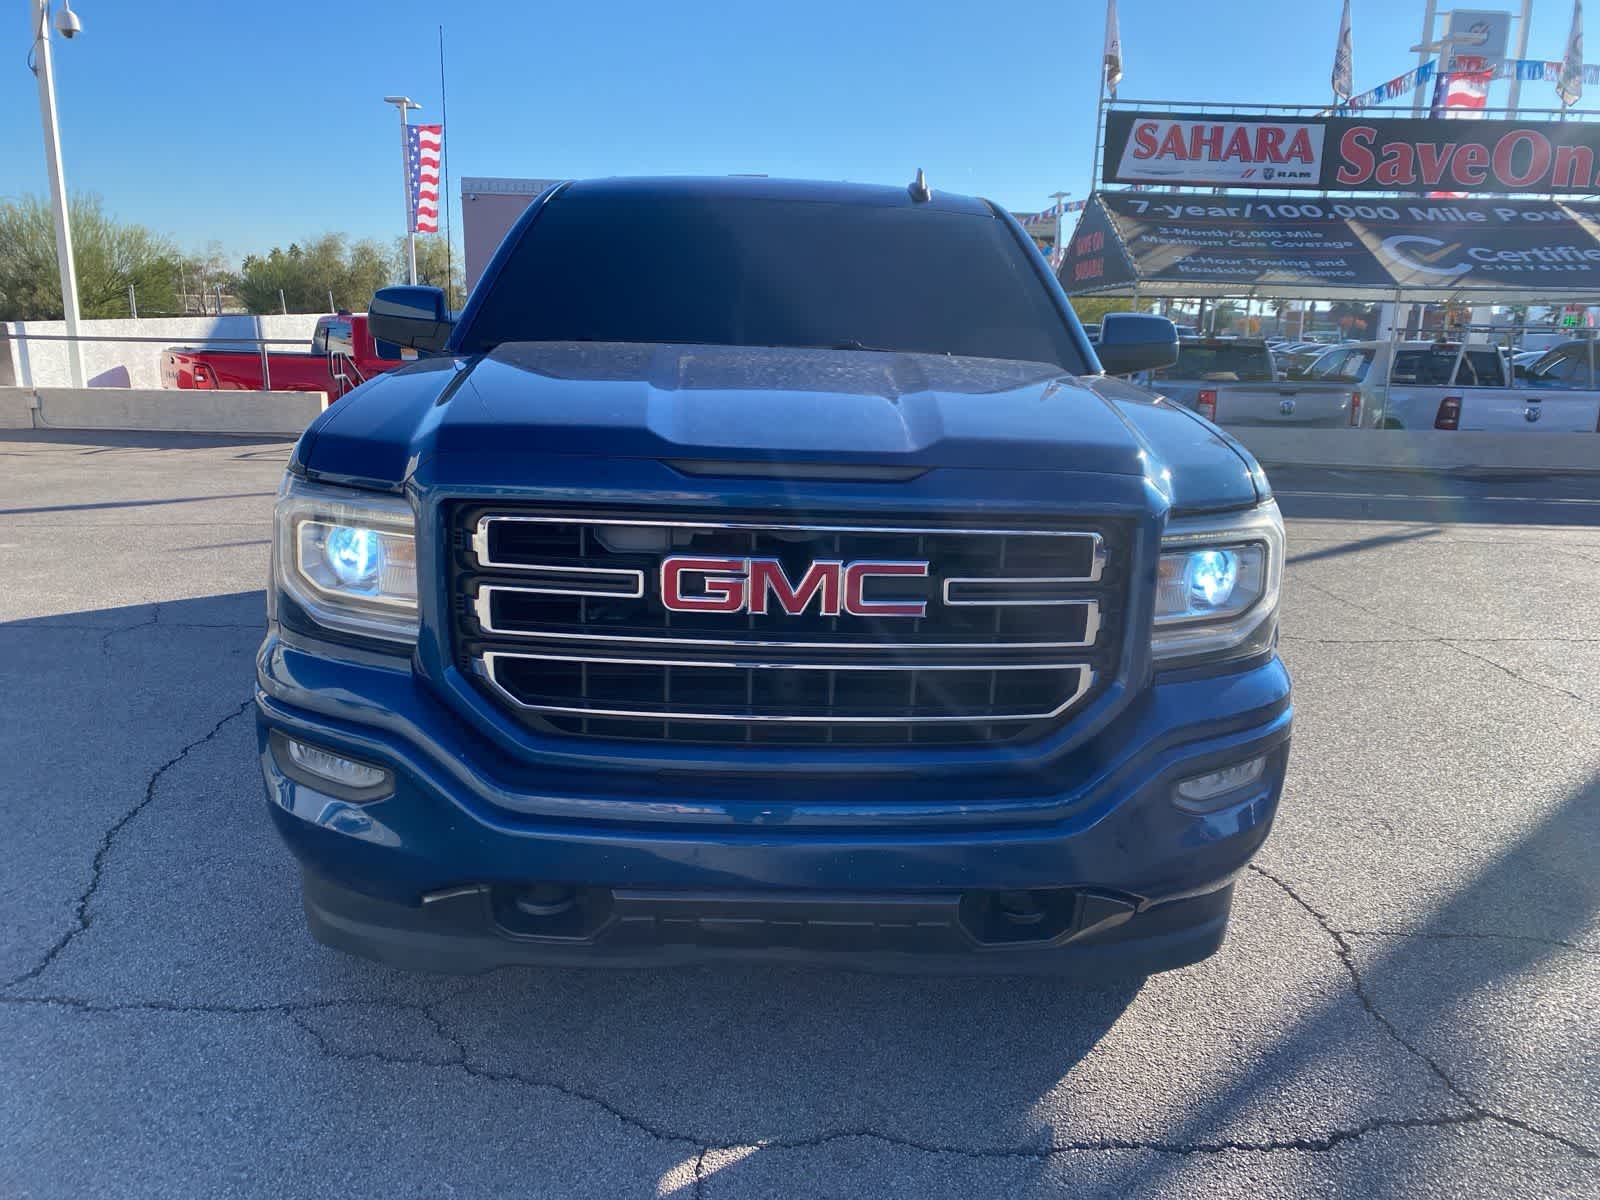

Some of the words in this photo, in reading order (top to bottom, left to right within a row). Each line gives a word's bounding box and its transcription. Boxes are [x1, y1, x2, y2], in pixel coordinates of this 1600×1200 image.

[1133, 122, 1315, 164] SAHARA
[1336, 126, 1600, 188] SaveOn
[1277, 171, 1312, 179] RAM
[1407, 206, 1488, 222] Mile
[1141, 234, 1225, 247] Maximum
[1228, 239, 1270, 248] Care
[1271, 240, 1354, 249] Coverage
[1467, 245, 1600, 262] Certifie
[1247, 257, 1312, 269] Towing
[1315, 258, 1348, 267] and
[660, 554, 930, 618] GMC
